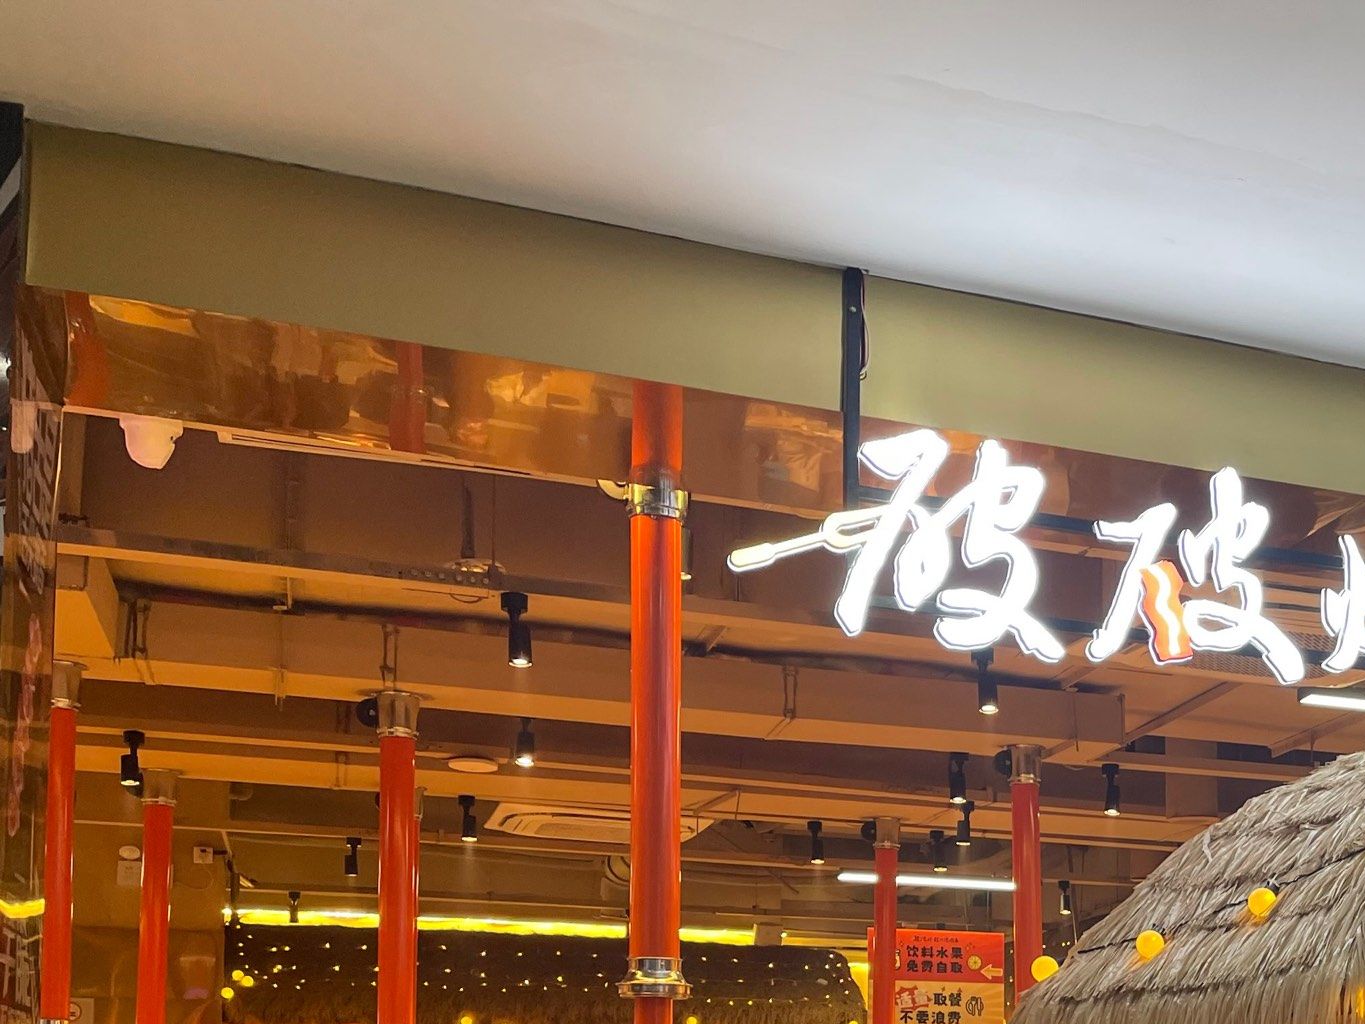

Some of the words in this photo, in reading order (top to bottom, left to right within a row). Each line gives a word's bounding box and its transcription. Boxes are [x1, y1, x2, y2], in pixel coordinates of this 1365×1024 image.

[906, 945, 963, 959] 饮料水果
[907, 960, 963, 973] 免费自取
[900, 1011, 961, 1024] 不要浪费
